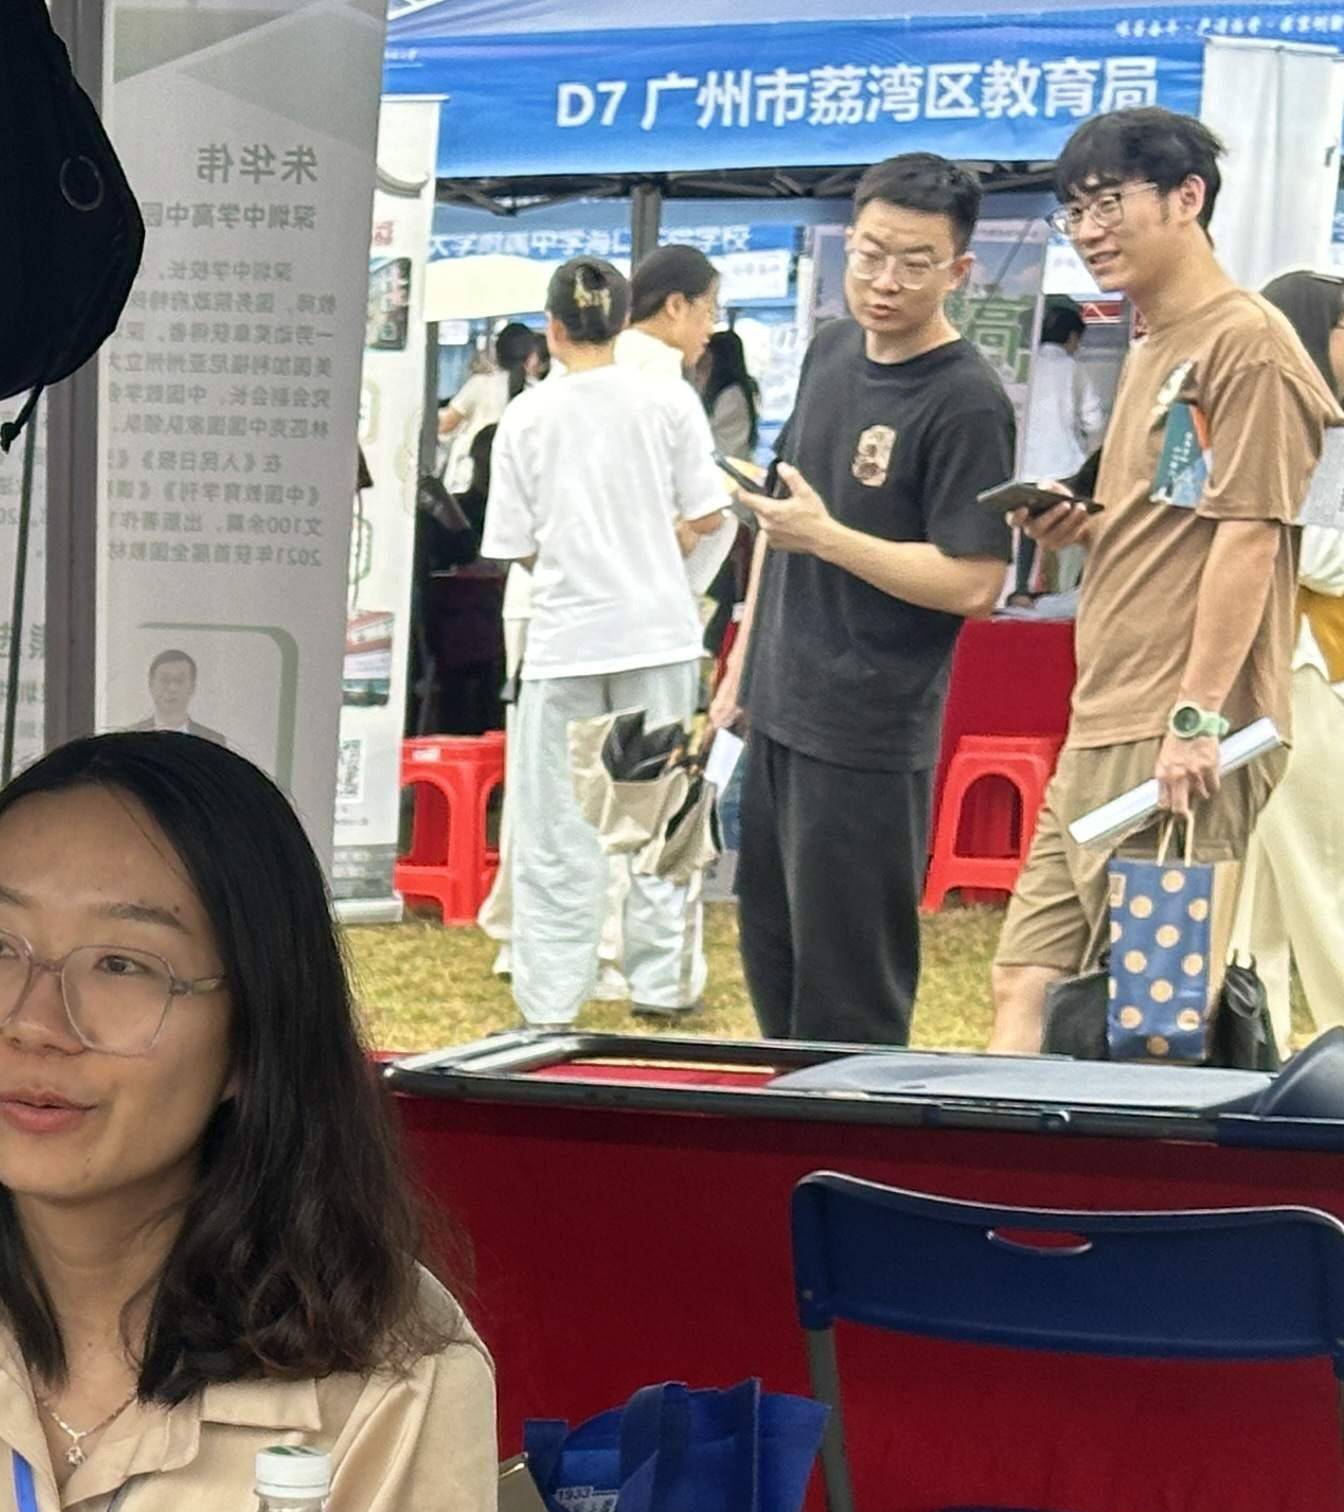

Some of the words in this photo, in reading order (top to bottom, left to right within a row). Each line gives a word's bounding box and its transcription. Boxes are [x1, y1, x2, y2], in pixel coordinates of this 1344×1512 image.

[556, 82, 628, 127] D7
[639, 57, 1158, 131] 广州市荔湾区教育局
